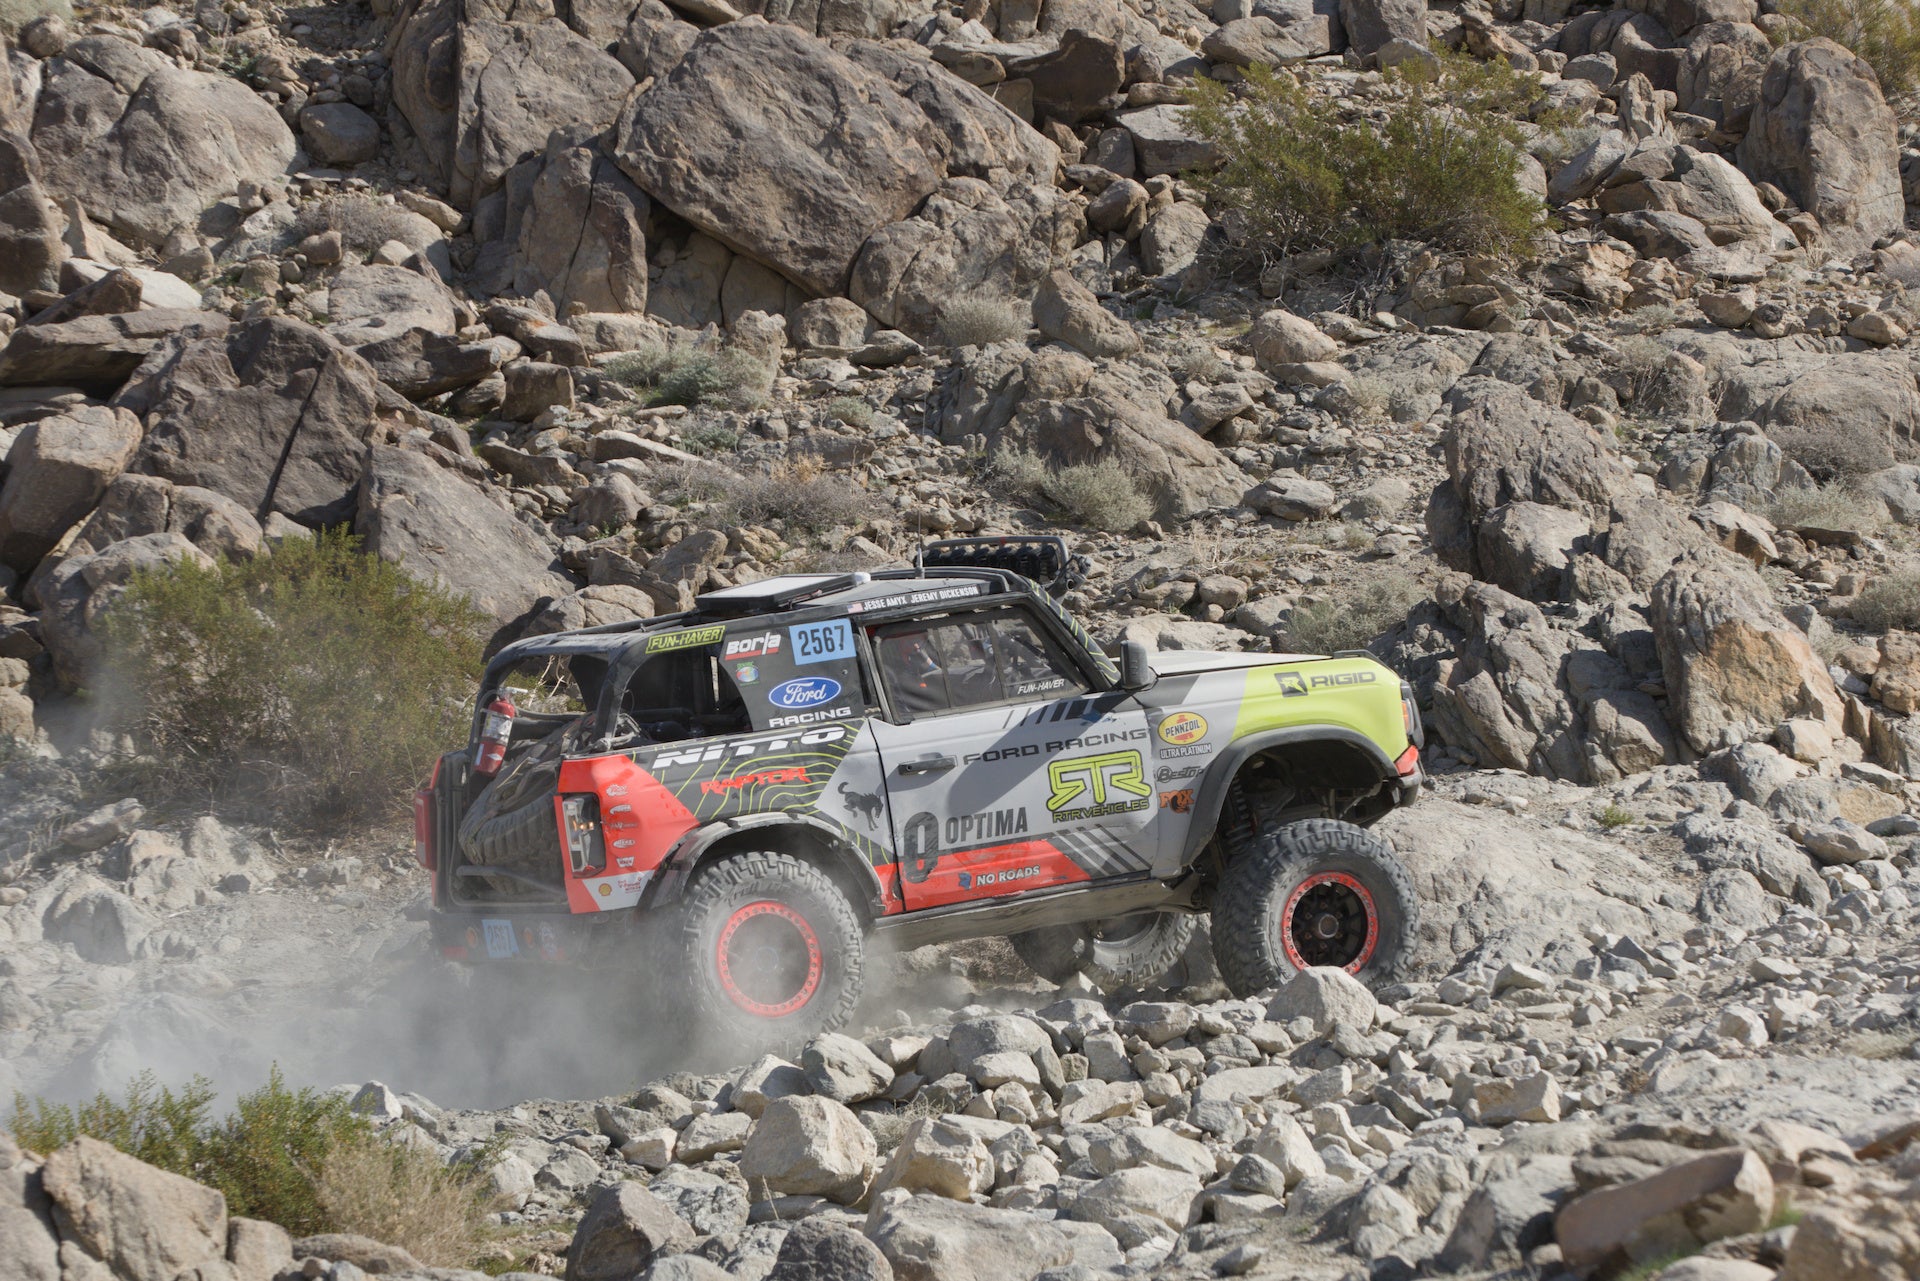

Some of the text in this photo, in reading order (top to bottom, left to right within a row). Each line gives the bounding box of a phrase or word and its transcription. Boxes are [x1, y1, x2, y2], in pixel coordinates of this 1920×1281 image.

[863, 586, 979, 611] JESSE AMYX JEREMY DICKENSON
[650, 628, 721, 650] FUN-HAVER
[798, 625, 845, 656] 2567
[1017, 678, 1065, 695] FUN-HAVER
[1310, 671, 1376, 688] RIGID
[783, 681, 827, 704] Ford
[769, 706, 852, 728] RACING
[1165, 719, 1201, 738] PENNZOIL
[652, 726, 846, 769] NITTO
[963, 728, 1148, 765] FORD RACING
[1160, 743, 1212, 760] ULTRA PLATINUM
[700, 768, 812, 796] RAPTOR
[1159, 789, 1195, 814] FOX
[945, 807, 1028, 844] OPTIMA
[976, 865, 1041, 887] NO ROADS
